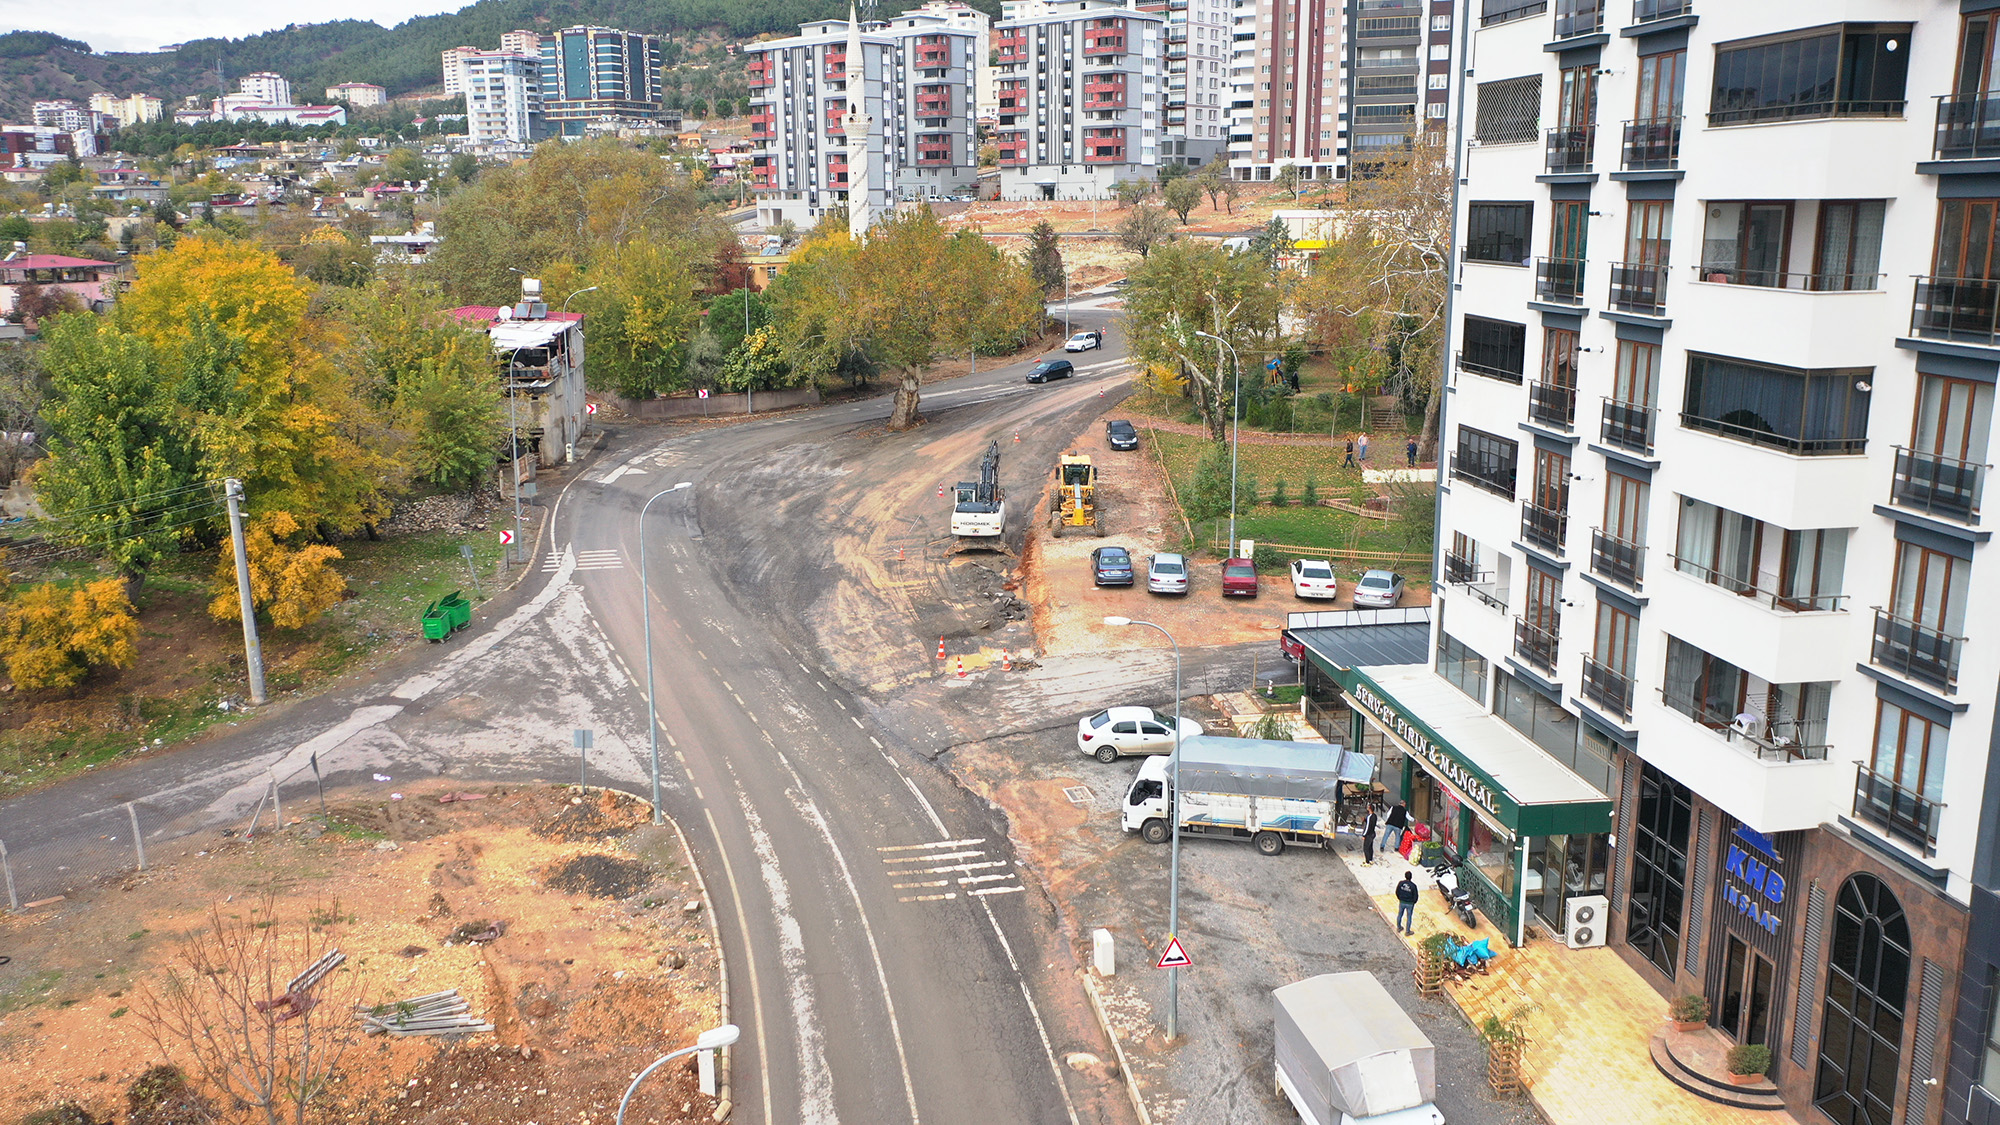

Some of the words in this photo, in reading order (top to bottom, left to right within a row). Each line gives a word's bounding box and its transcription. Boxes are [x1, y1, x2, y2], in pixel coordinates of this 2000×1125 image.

[1397, 718, 1428, 757] FIRIN
[1428, 745, 1437, 764] &
[1439, 753, 1496, 815] MANGAL
[1725, 843, 1787, 904] KHB
